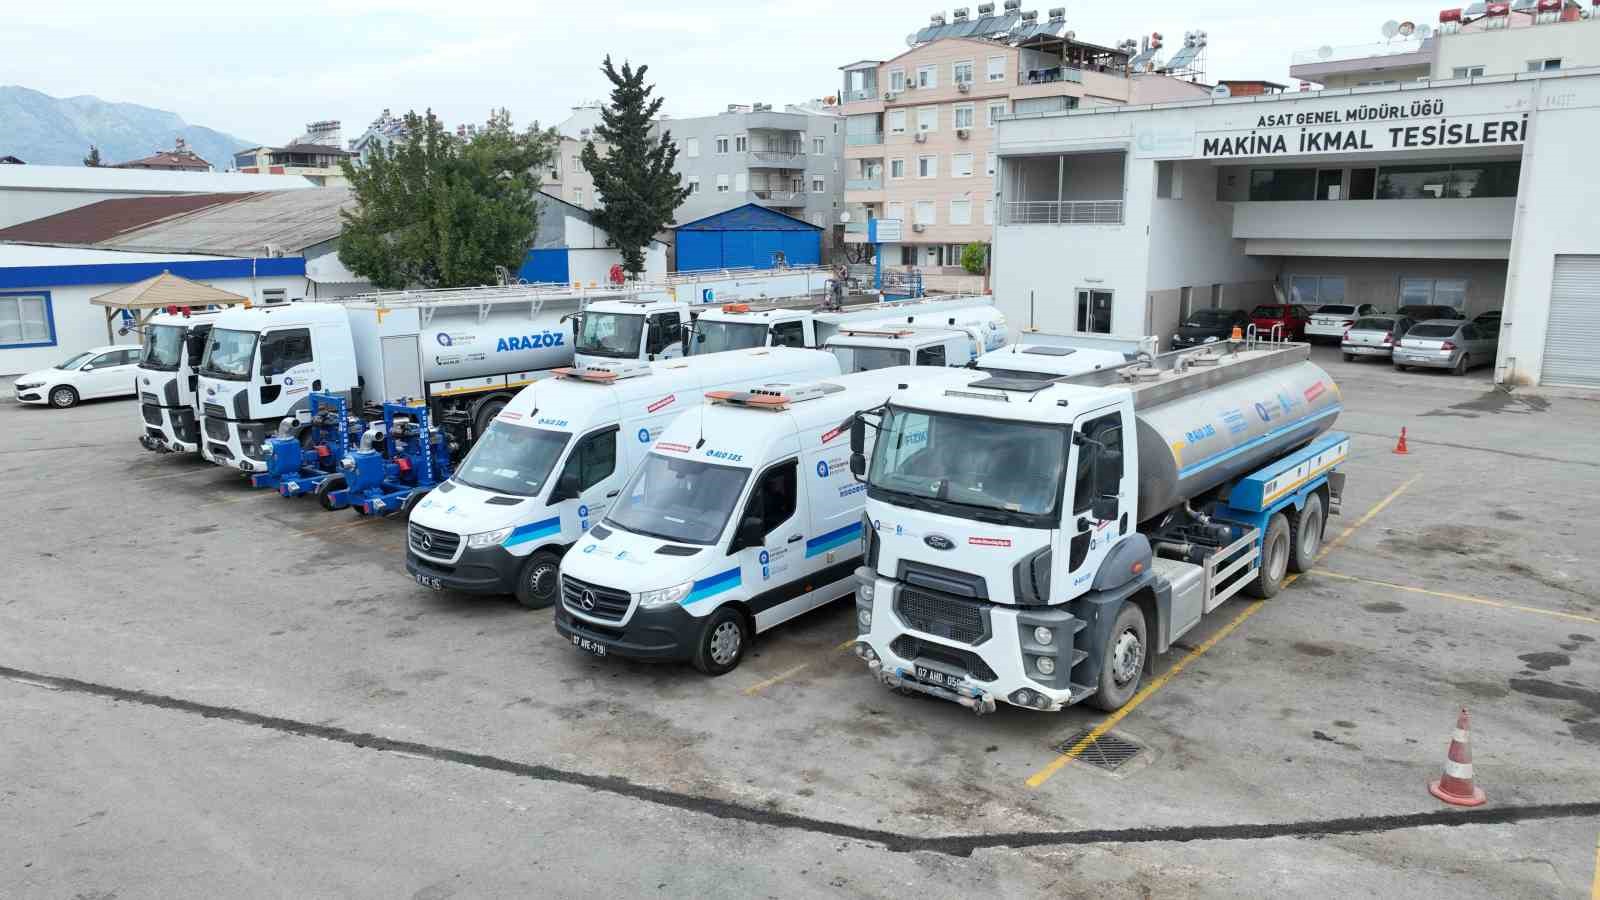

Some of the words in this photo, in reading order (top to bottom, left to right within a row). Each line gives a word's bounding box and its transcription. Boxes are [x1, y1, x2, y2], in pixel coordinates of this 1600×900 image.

[1257, 113, 1293, 127] ASAT
[1296, 110, 1342, 125] GENEL
[1345, 99, 1444, 121] MÜDÜRLÜĞÜ
[1203, 130, 1287, 156] MAKİNA
[1300, 127, 1373, 152] İKMAL
[1389, 113, 1528, 147] TESİSLERİ
[496, 330, 564, 352] ARAZÖZ
[918, 667, 927, 680] 07
